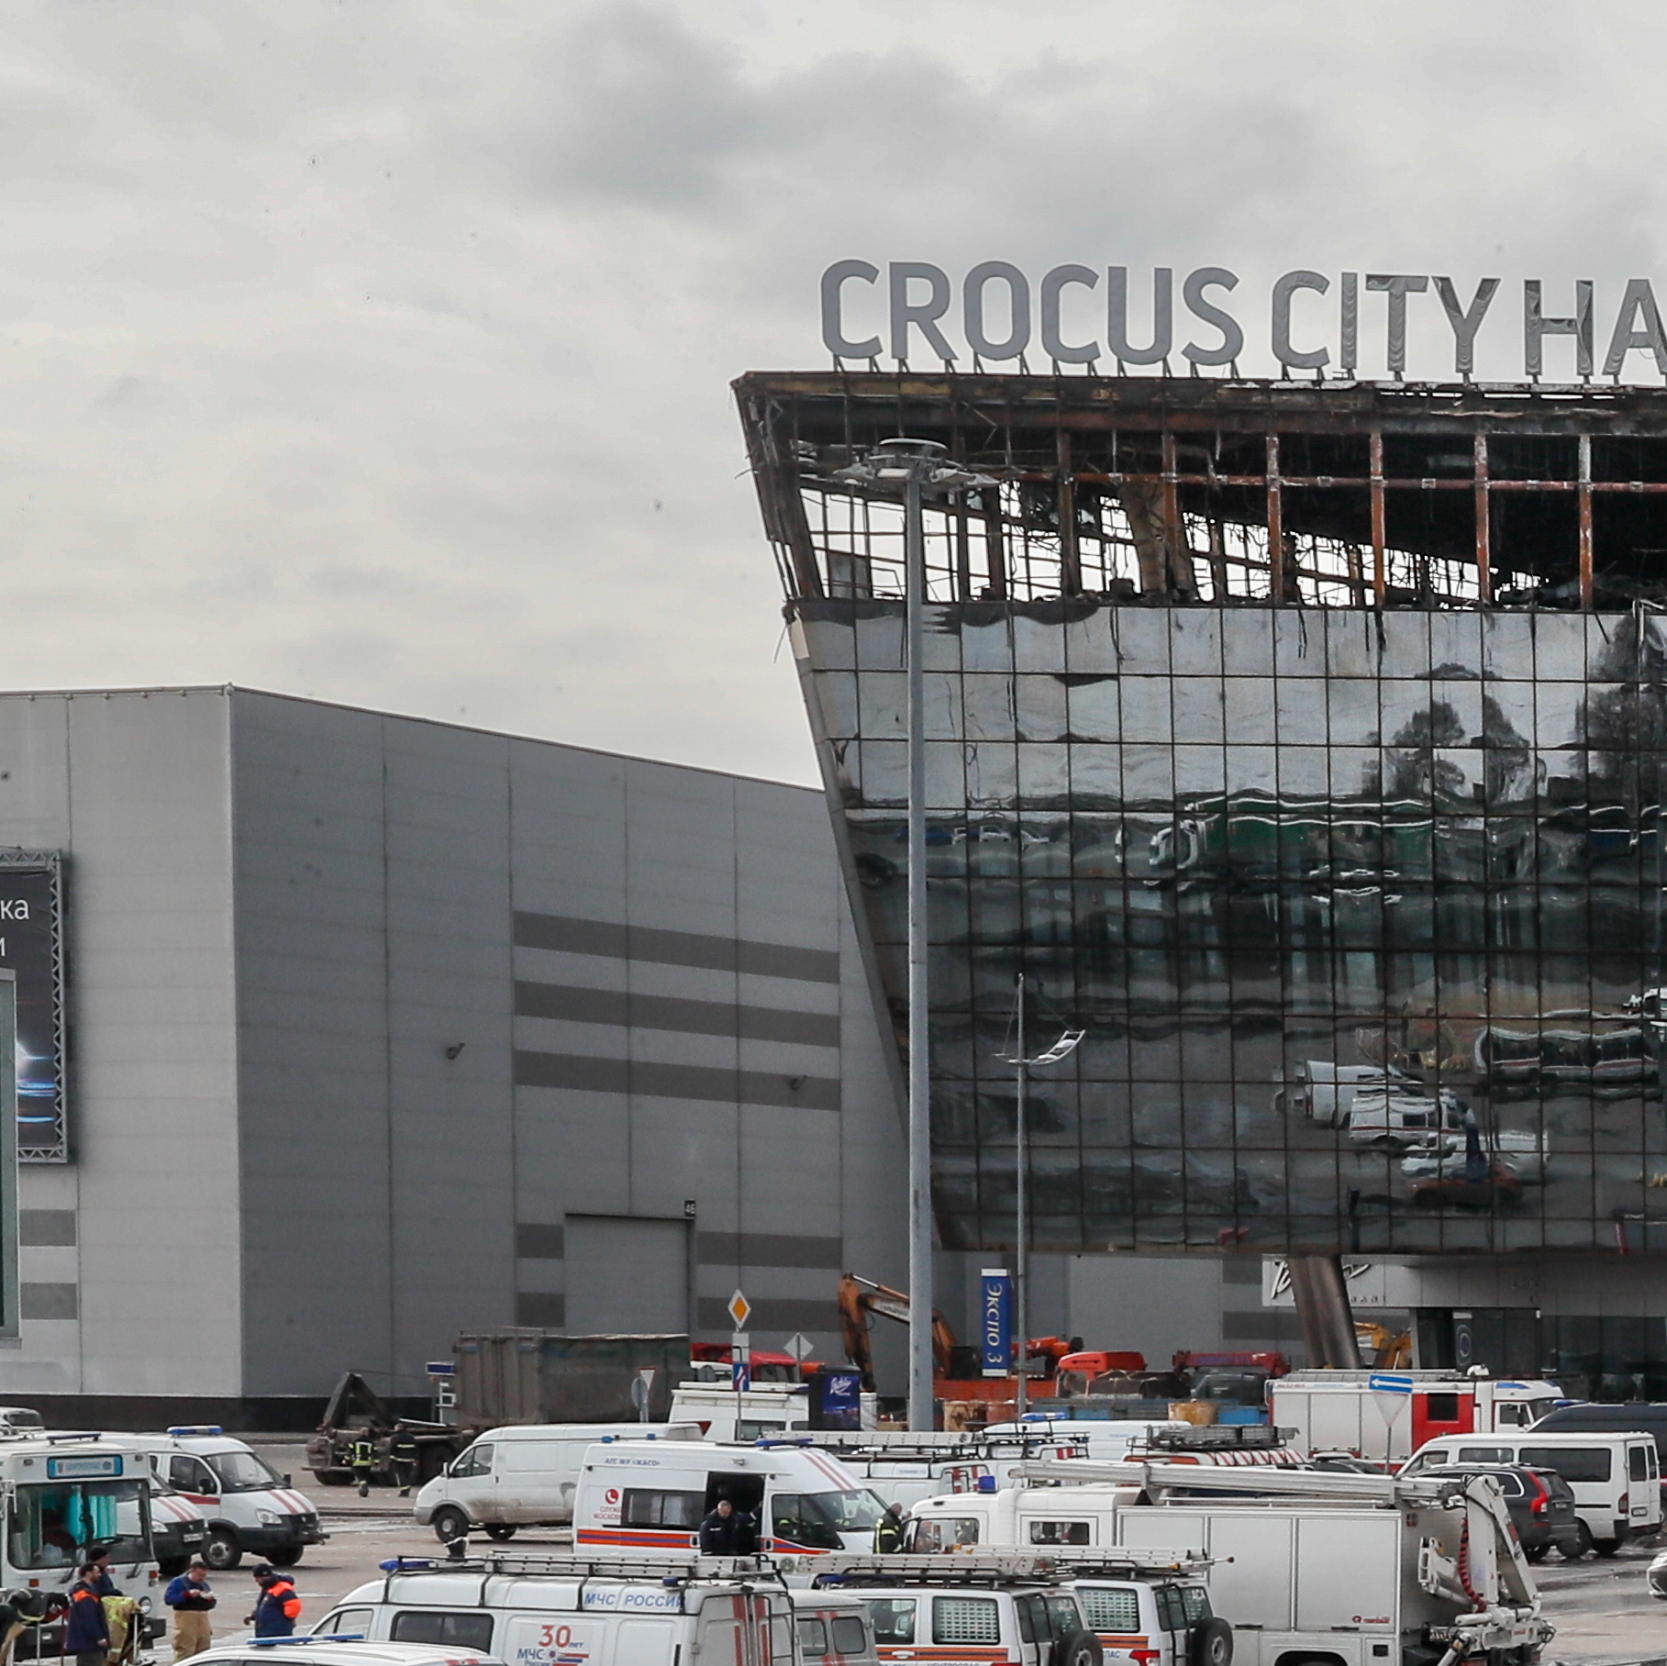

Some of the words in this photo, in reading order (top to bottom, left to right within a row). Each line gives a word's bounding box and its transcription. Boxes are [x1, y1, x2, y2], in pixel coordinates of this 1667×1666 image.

[820, 259, 1244, 369] CROCUS
[1271, 269, 1501, 373] CITY
[584, 1593, 616, 1605] МЧС
[538, 1625, 571, 1648] 30
[517, 1648, 545, 1660] МЧС
